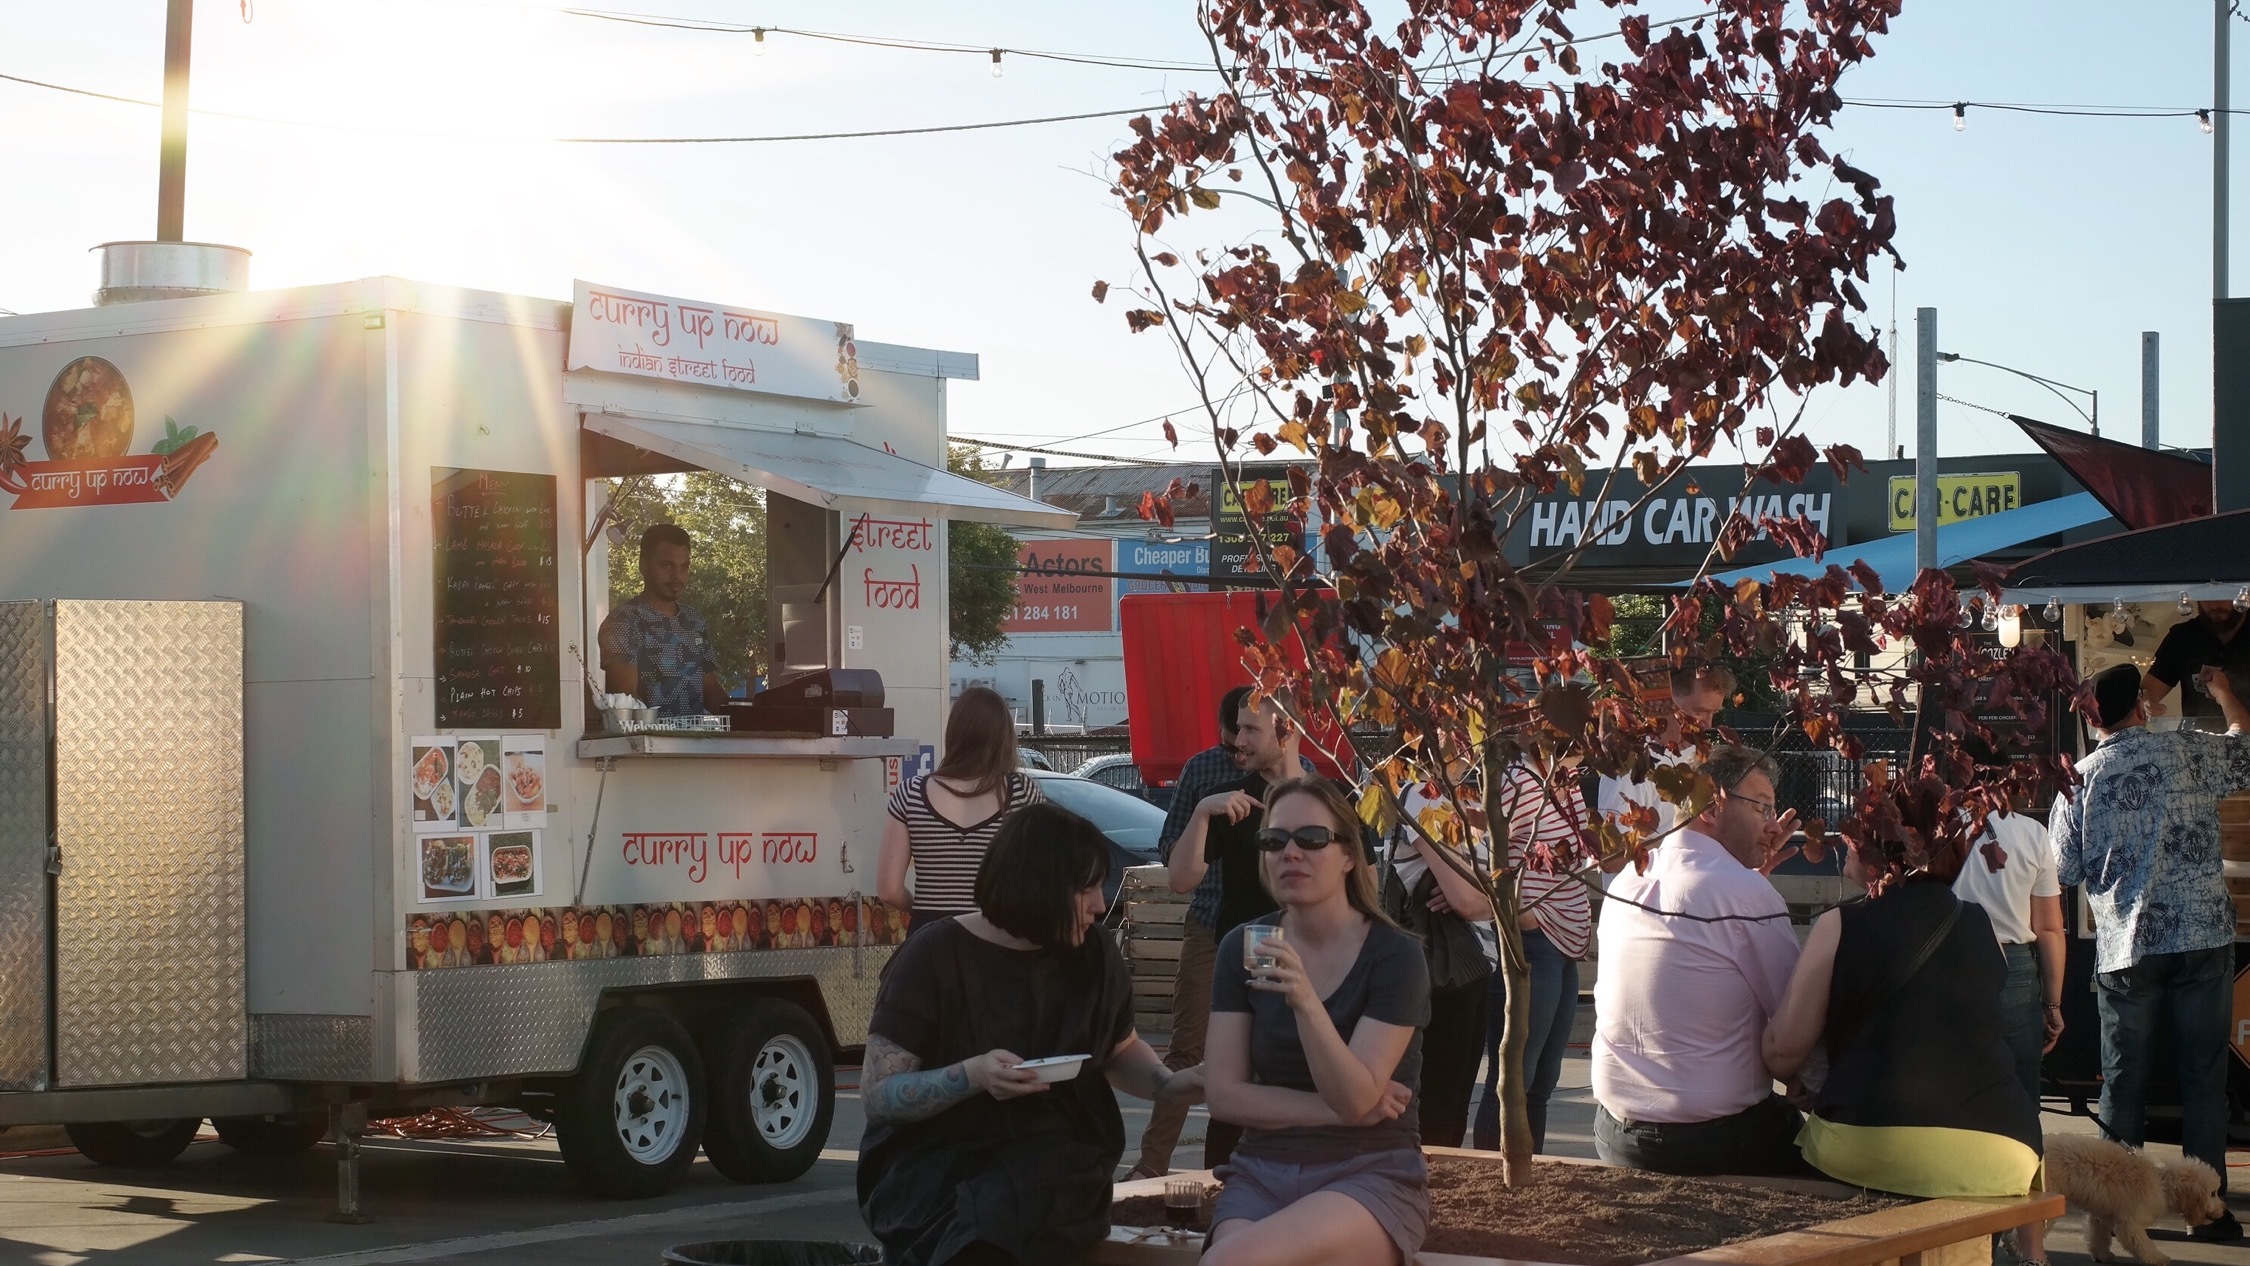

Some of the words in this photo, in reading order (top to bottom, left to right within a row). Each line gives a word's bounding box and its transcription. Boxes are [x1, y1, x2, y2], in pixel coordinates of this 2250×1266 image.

[589, 290, 670, 346] curry
[678, 305, 713, 349] up
[723, 311, 779, 346] now
[618, 344, 663, 372] indian
[667, 355, 717, 377] street
[722, 359, 755, 384] food
[31, 471, 80, 498] curry
[86, 469, 107, 495] up
[113, 467, 149, 487] now
[849, 512, 933, 553] street
[1530, 500, 1633, 547] HAND
[1643, 497, 1717, 546] CAR
[1270, 533, 1290, 542] 227
[1024, 552, 1104, 578] Actors
[1134, 547, 1192, 568] Cheaper
[864, 563, 920, 609] food
[1024, 583, 1048, 594] West
[1052, 583, 1104, 594] Melbourne
[1024, 606, 1049, 620] 284
[1054, 605, 1078, 620] 181
[450, 687, 474, 704] PLAIN
[480, 687, 496, 699] HOT
[502, 685, 521, 697] CHIPS
[619, 719, 677, 733] Welcome
[622, 832, 708, 883] curry
[717, 832, 753, 880] up
[762, 832, 818, 865] now
